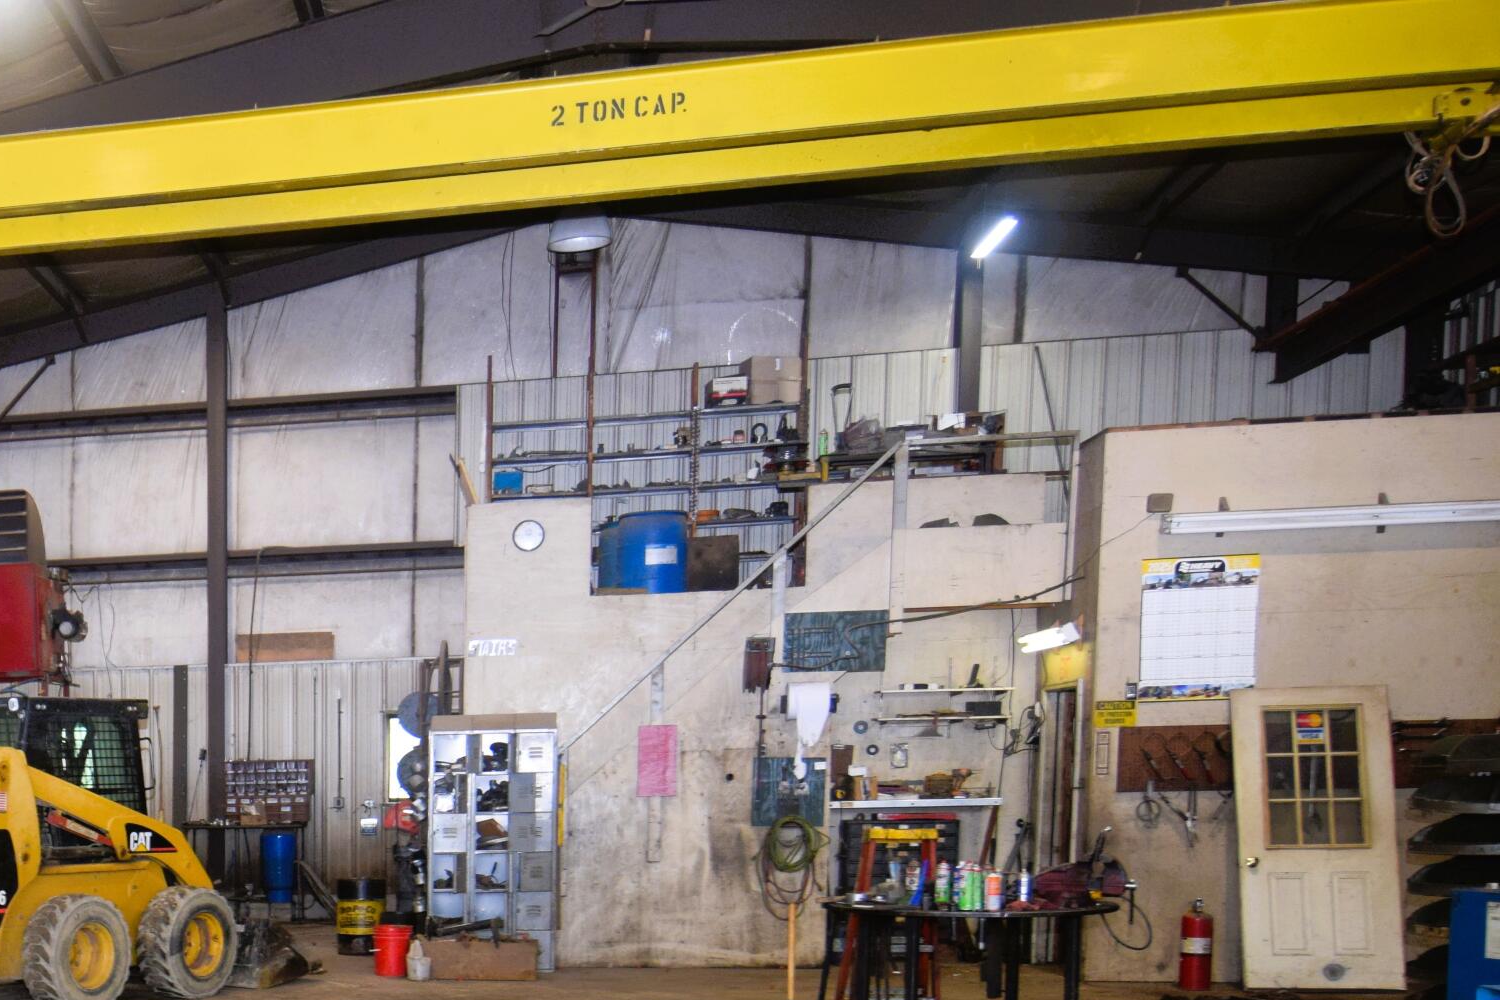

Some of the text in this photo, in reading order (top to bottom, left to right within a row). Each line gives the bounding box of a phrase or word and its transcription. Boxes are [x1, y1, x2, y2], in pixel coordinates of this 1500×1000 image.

[551, 91, 688, 127] 2 TON CAP.
[468, 638, 517, 657] STAIRS
[130, 831, 153, 852] CAT
